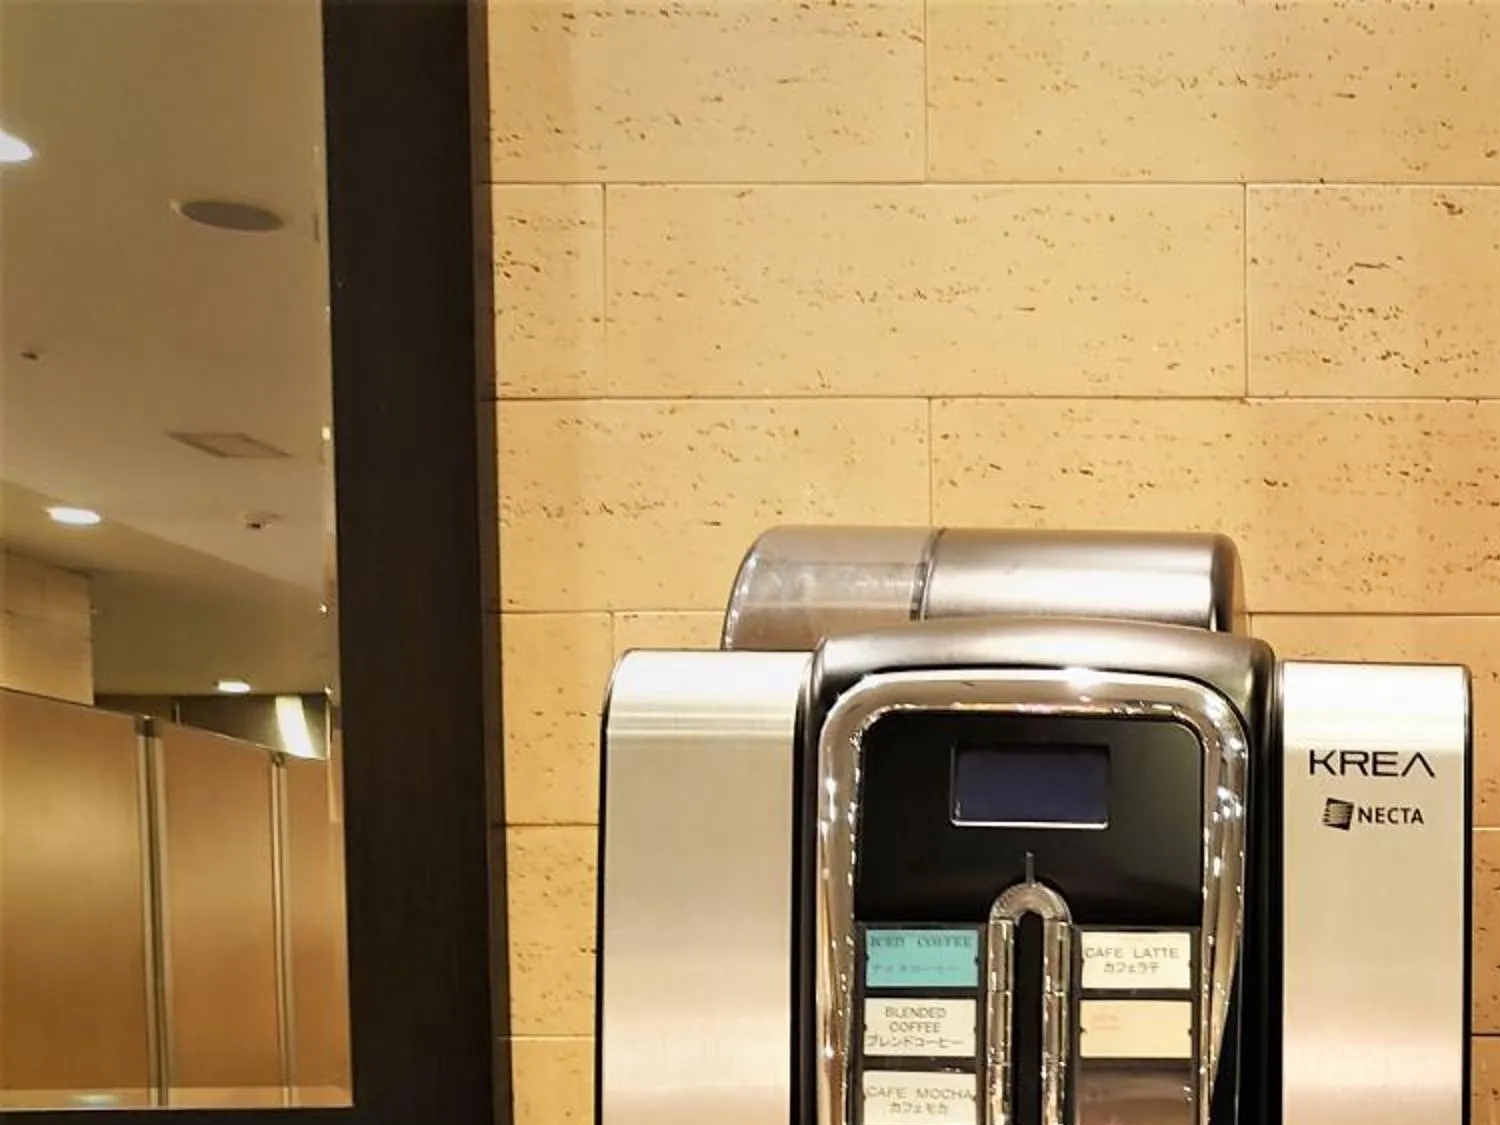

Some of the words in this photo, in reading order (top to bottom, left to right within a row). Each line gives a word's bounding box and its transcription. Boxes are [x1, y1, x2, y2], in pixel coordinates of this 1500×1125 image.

[1309, 749, 1436, 778] KREA
[1357, 807, 1424, 824] NECTA
[917, 935, 973, 948] COFFEE
[1085, 947, 1123, 959] CAFE
[1133, 947, 1180, 959] LATTE
[1104, 961, 1161, 974] カフェラテ
[884, 1006, 948, 1019] BLENDED
[889, 1021, 941, 1034] COFFEE
[865, 1034, 964, 1049] ブレンドコーヒー
[866, 1086, 908, 1098] CAFE
[916, 1088, 974, 1100] MOCHA
[888, 1102, 949, 1115] カフェモカ
